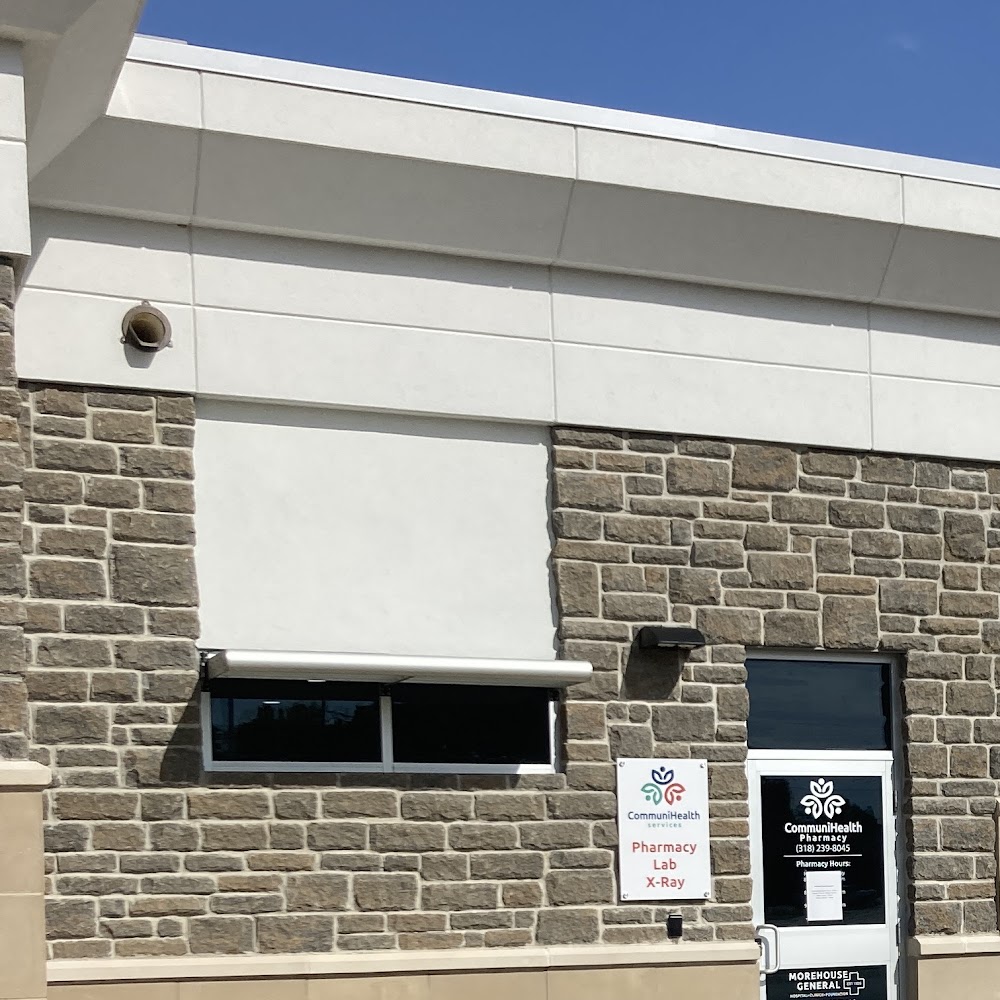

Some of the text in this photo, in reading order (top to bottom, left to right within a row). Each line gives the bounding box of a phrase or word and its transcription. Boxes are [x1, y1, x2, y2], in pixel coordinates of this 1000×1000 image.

[628, 810, 700, 820] CommuniHealth
[784, 821, 862, 833] CommuniHealth
[800, 834, 848, 843] Pharmacy
[632, 841, 697, 854] Pharmacy
[796, 844, 851, 853] (318) 239-8045
[654, 859, 677, 870] Lab
[796, 860, 828, 869] Pharmacy
[646, 877, 685, 890] X-Ray
[788, 971, 848, 982] MOREHOUSE
[796, 981, 841, 991] GENERAL
